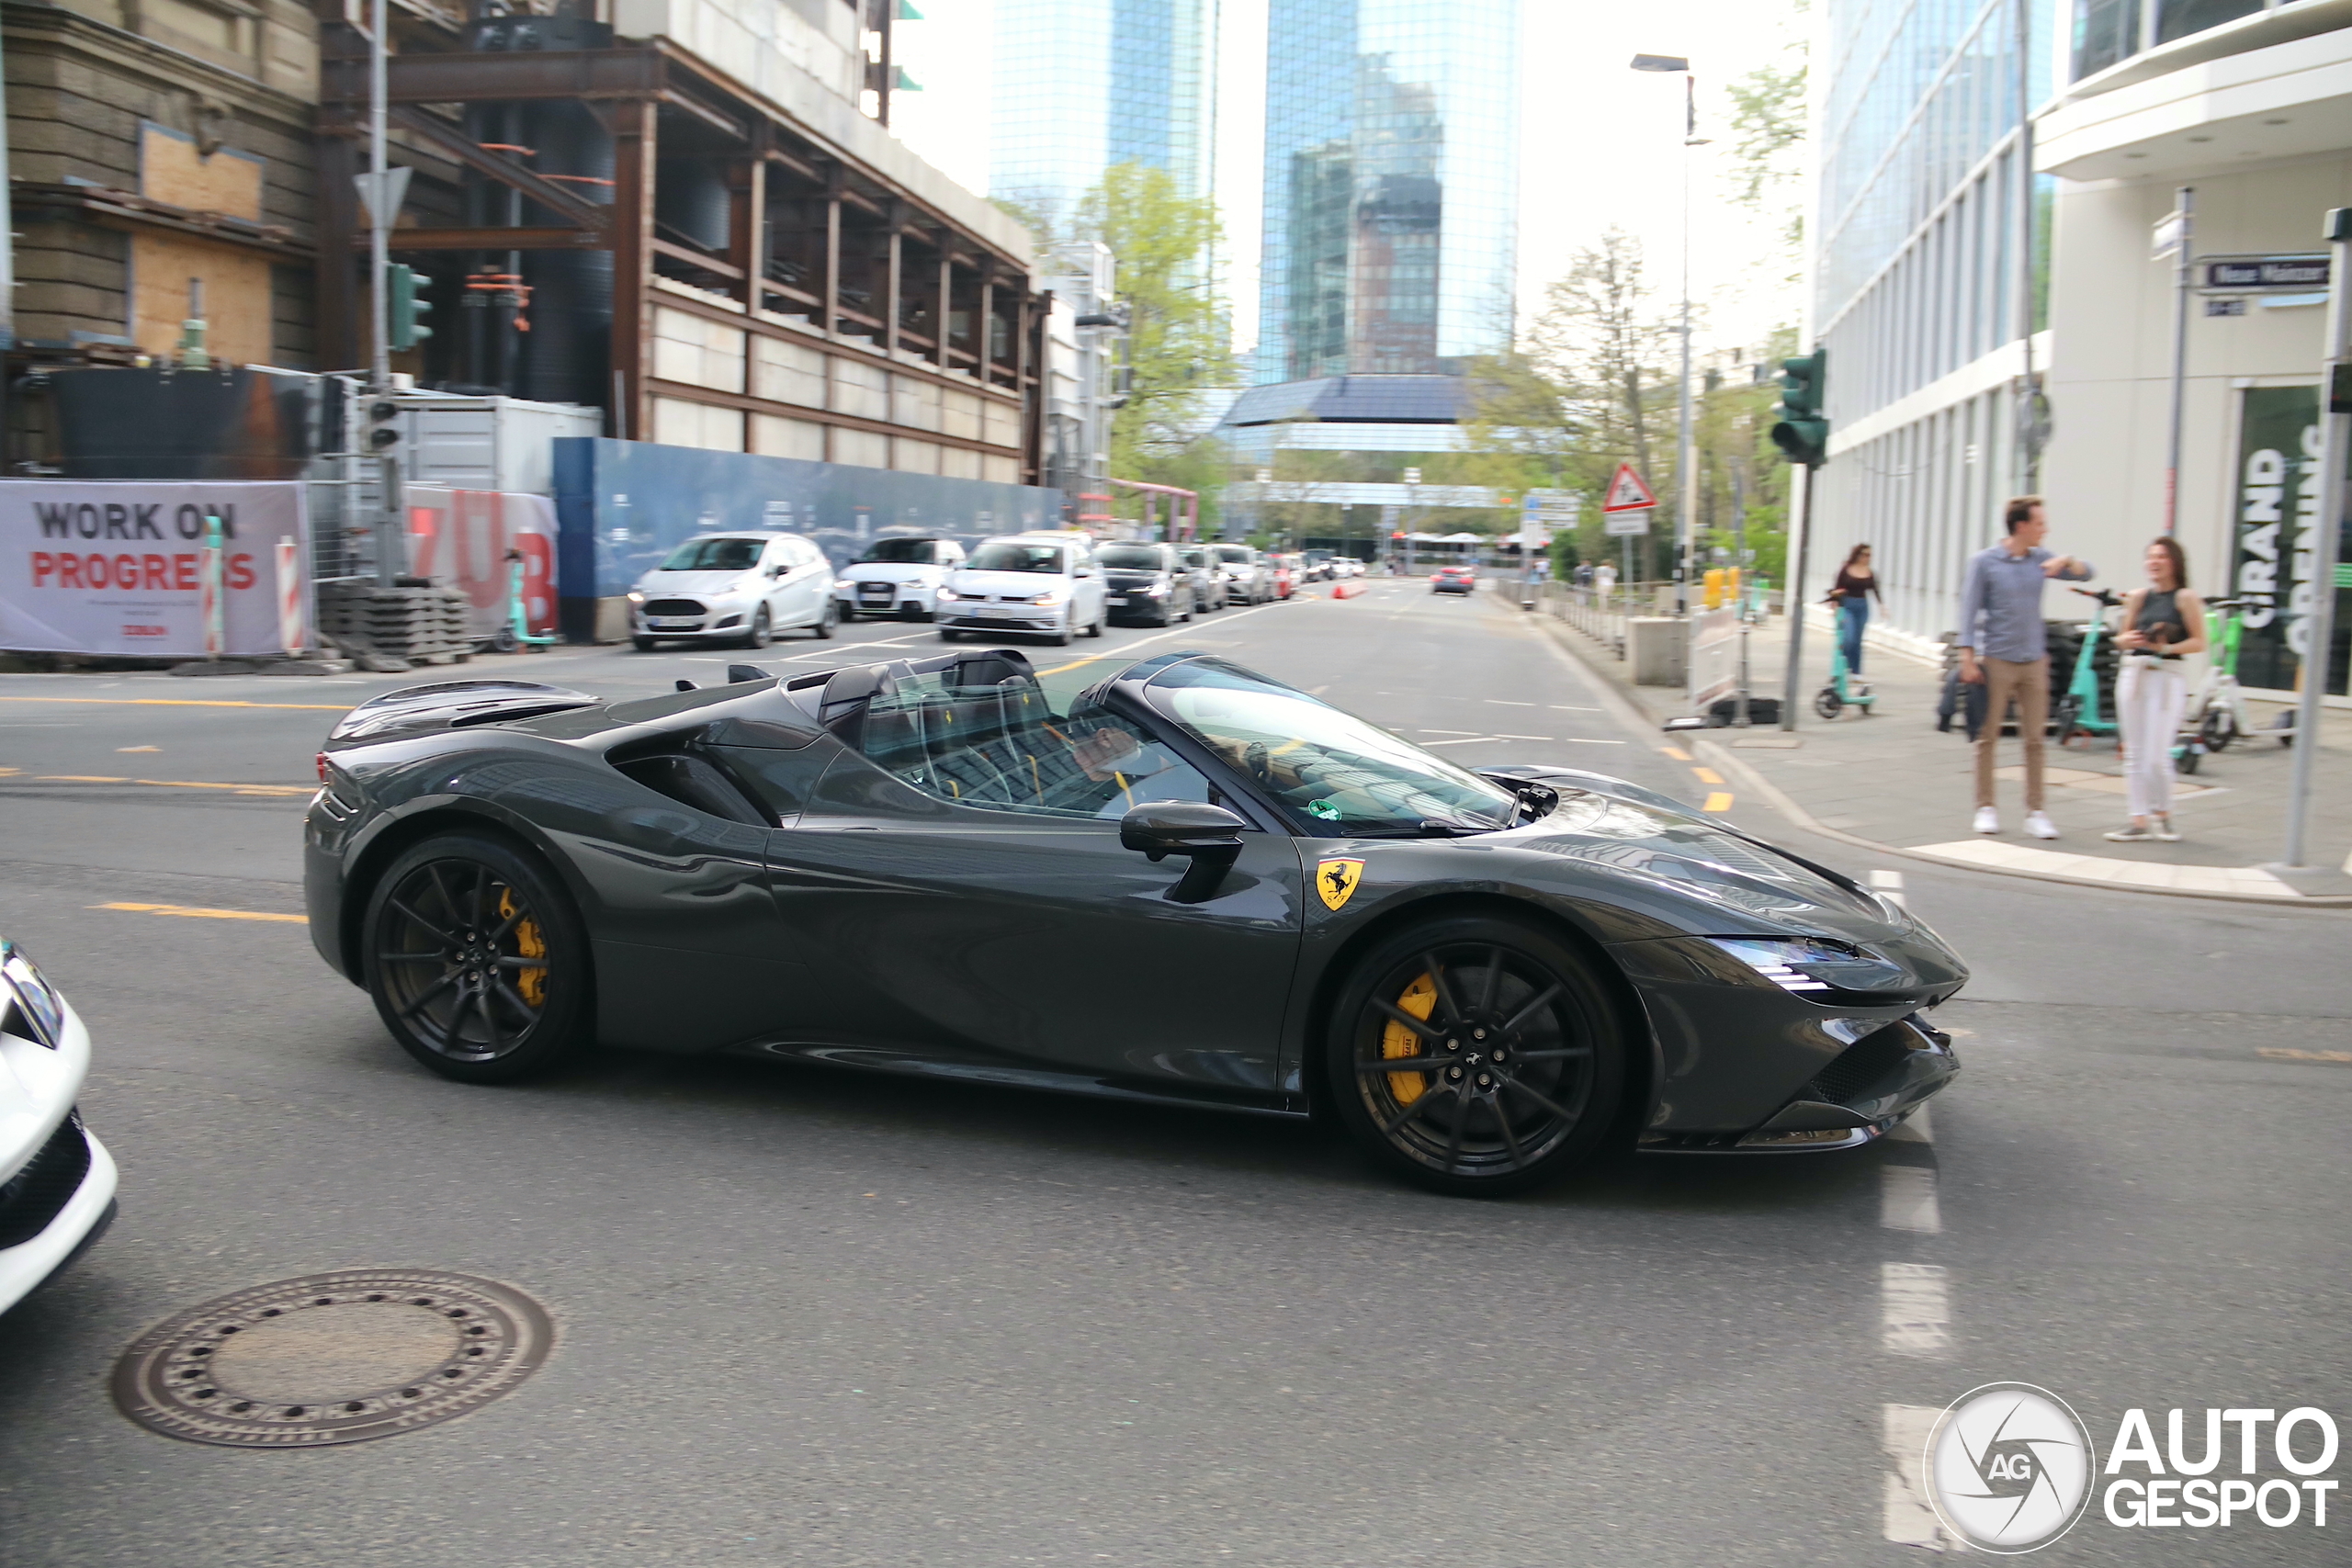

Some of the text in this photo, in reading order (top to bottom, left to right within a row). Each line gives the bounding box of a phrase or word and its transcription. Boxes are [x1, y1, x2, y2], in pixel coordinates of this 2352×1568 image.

[32, 502, 165, 540] WORK
[2238, 448, 2285, 628] GRAND
[30, 551, 257, 591] PROGRES
